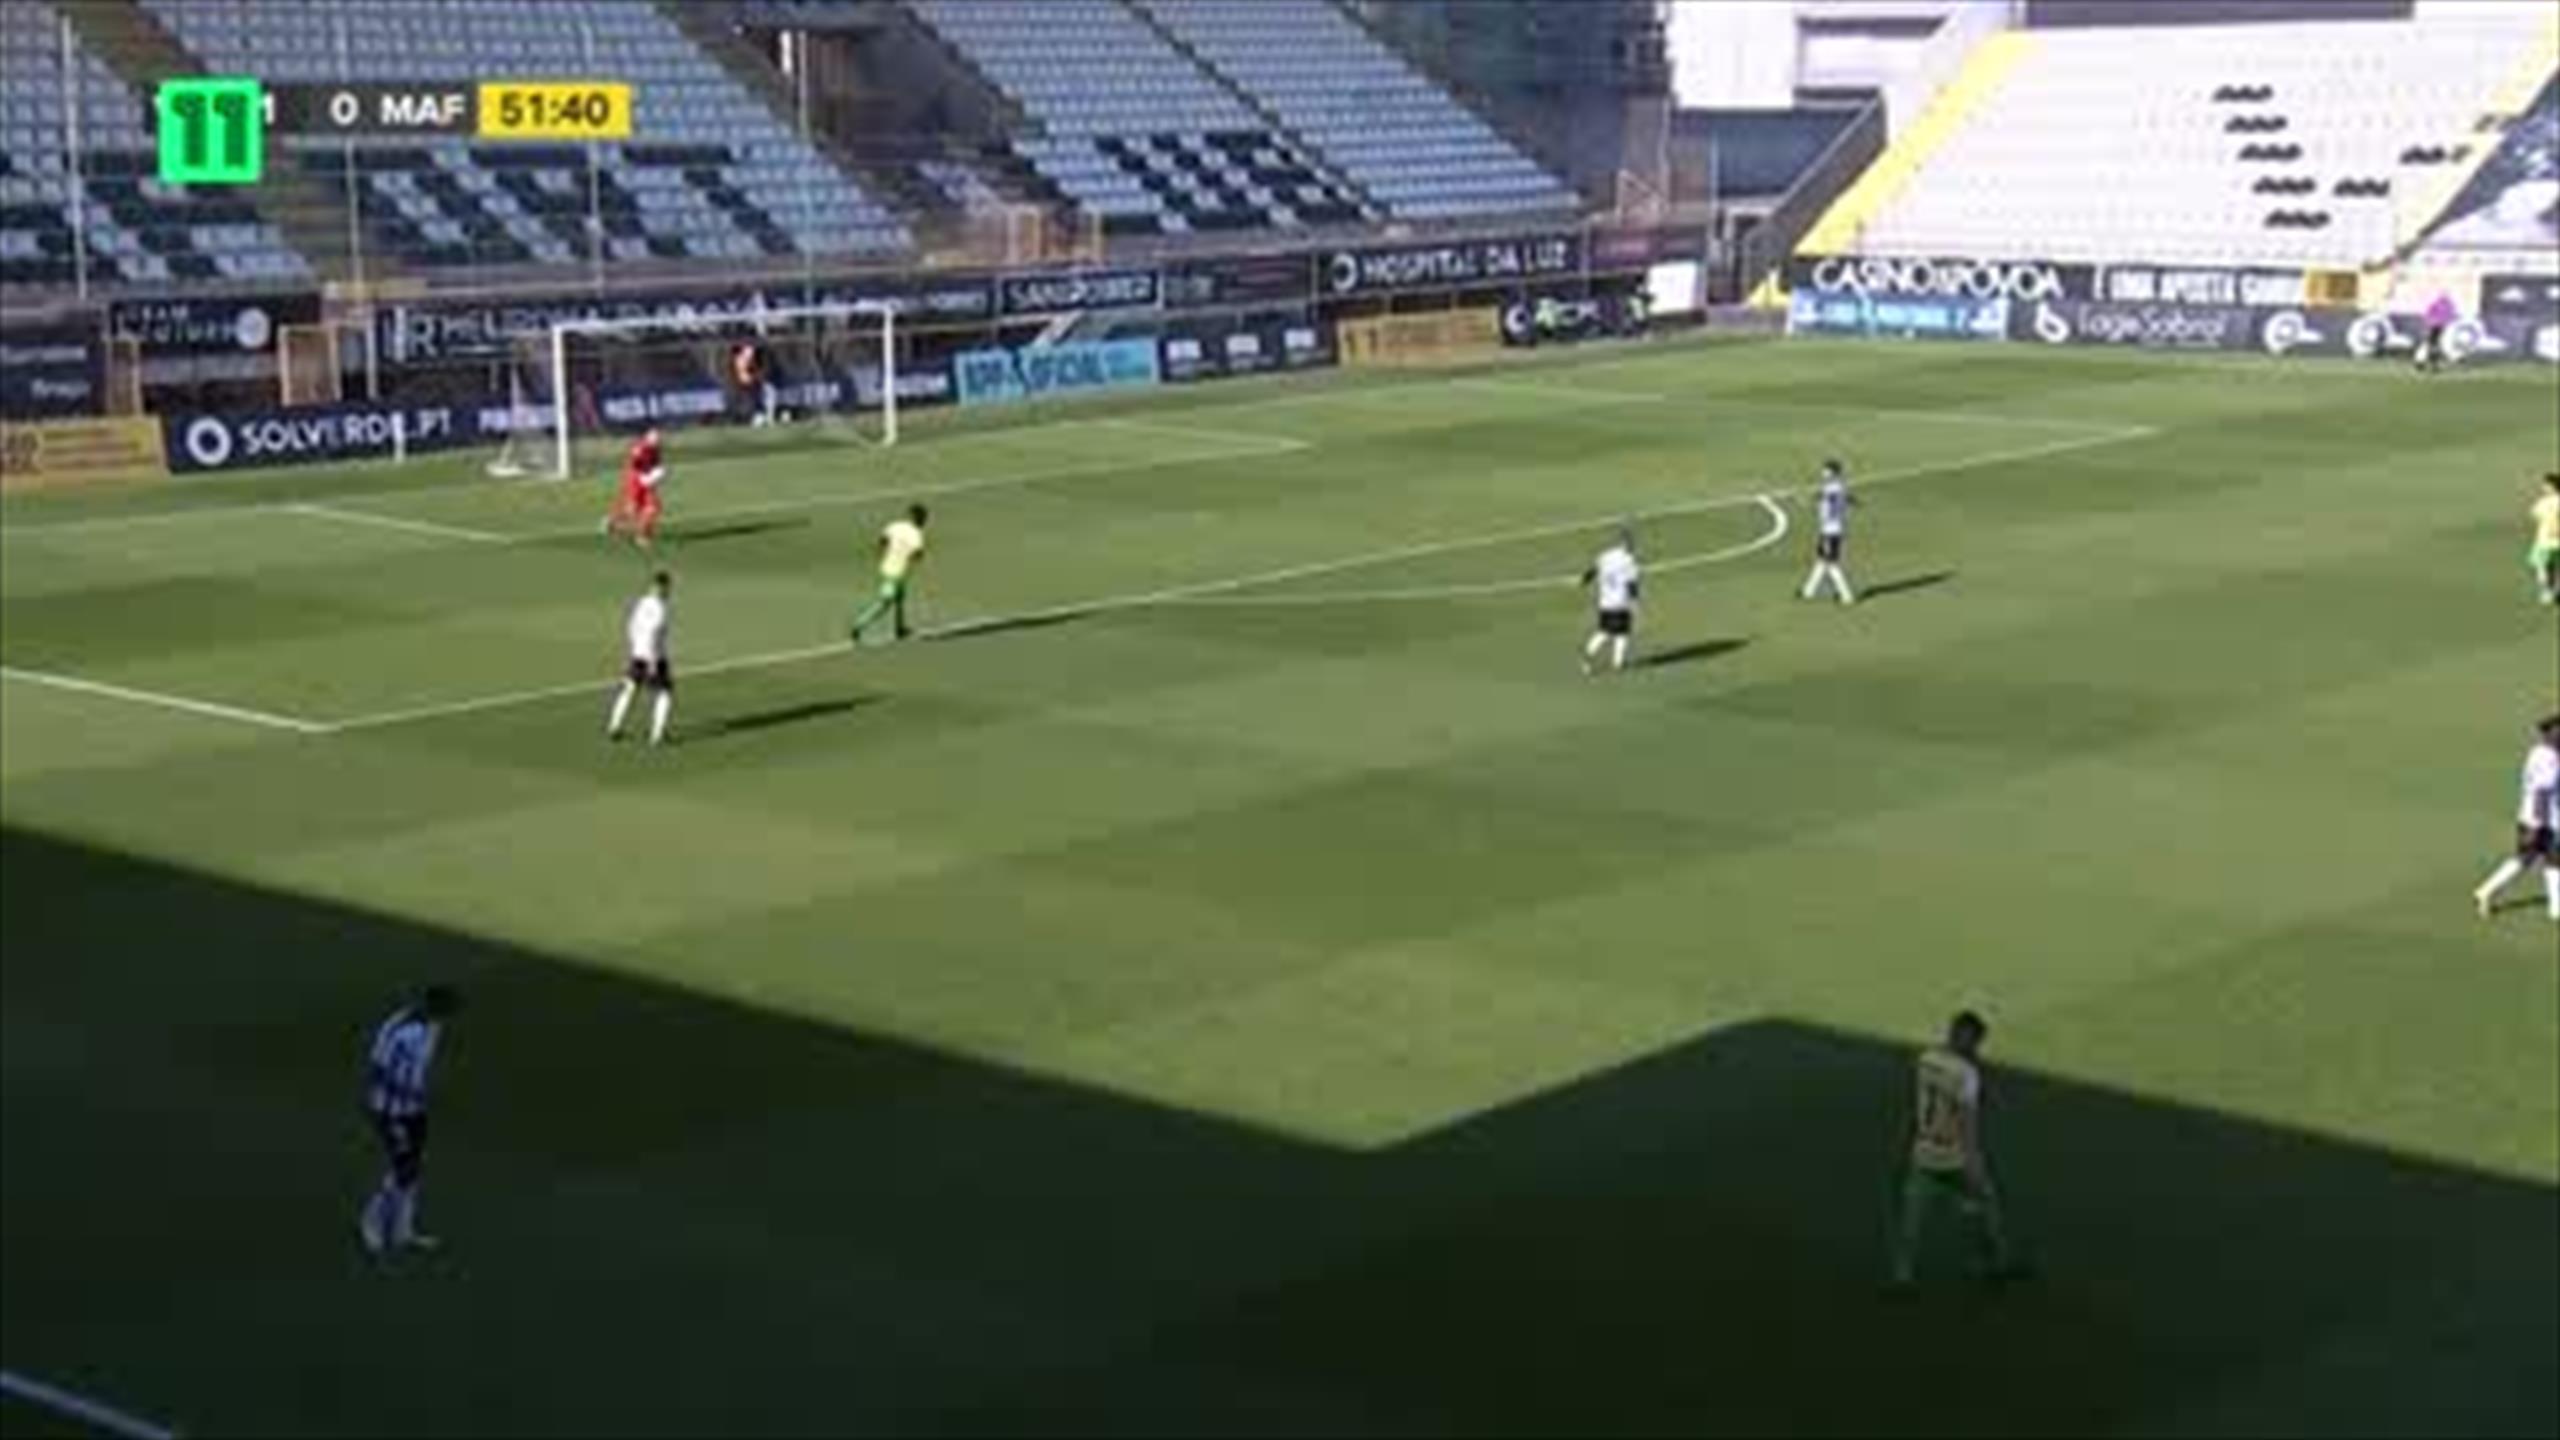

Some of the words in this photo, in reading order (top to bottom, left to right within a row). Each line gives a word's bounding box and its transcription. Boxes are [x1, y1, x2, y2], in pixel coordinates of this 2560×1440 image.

[1363, 246, 1476, 285] HOSPITAL
[1485, 243, 1519, 275] DA
[1525, 240, 1567, 272] LUZ
[240, 407, 450, 455] SOLVERD.PT
